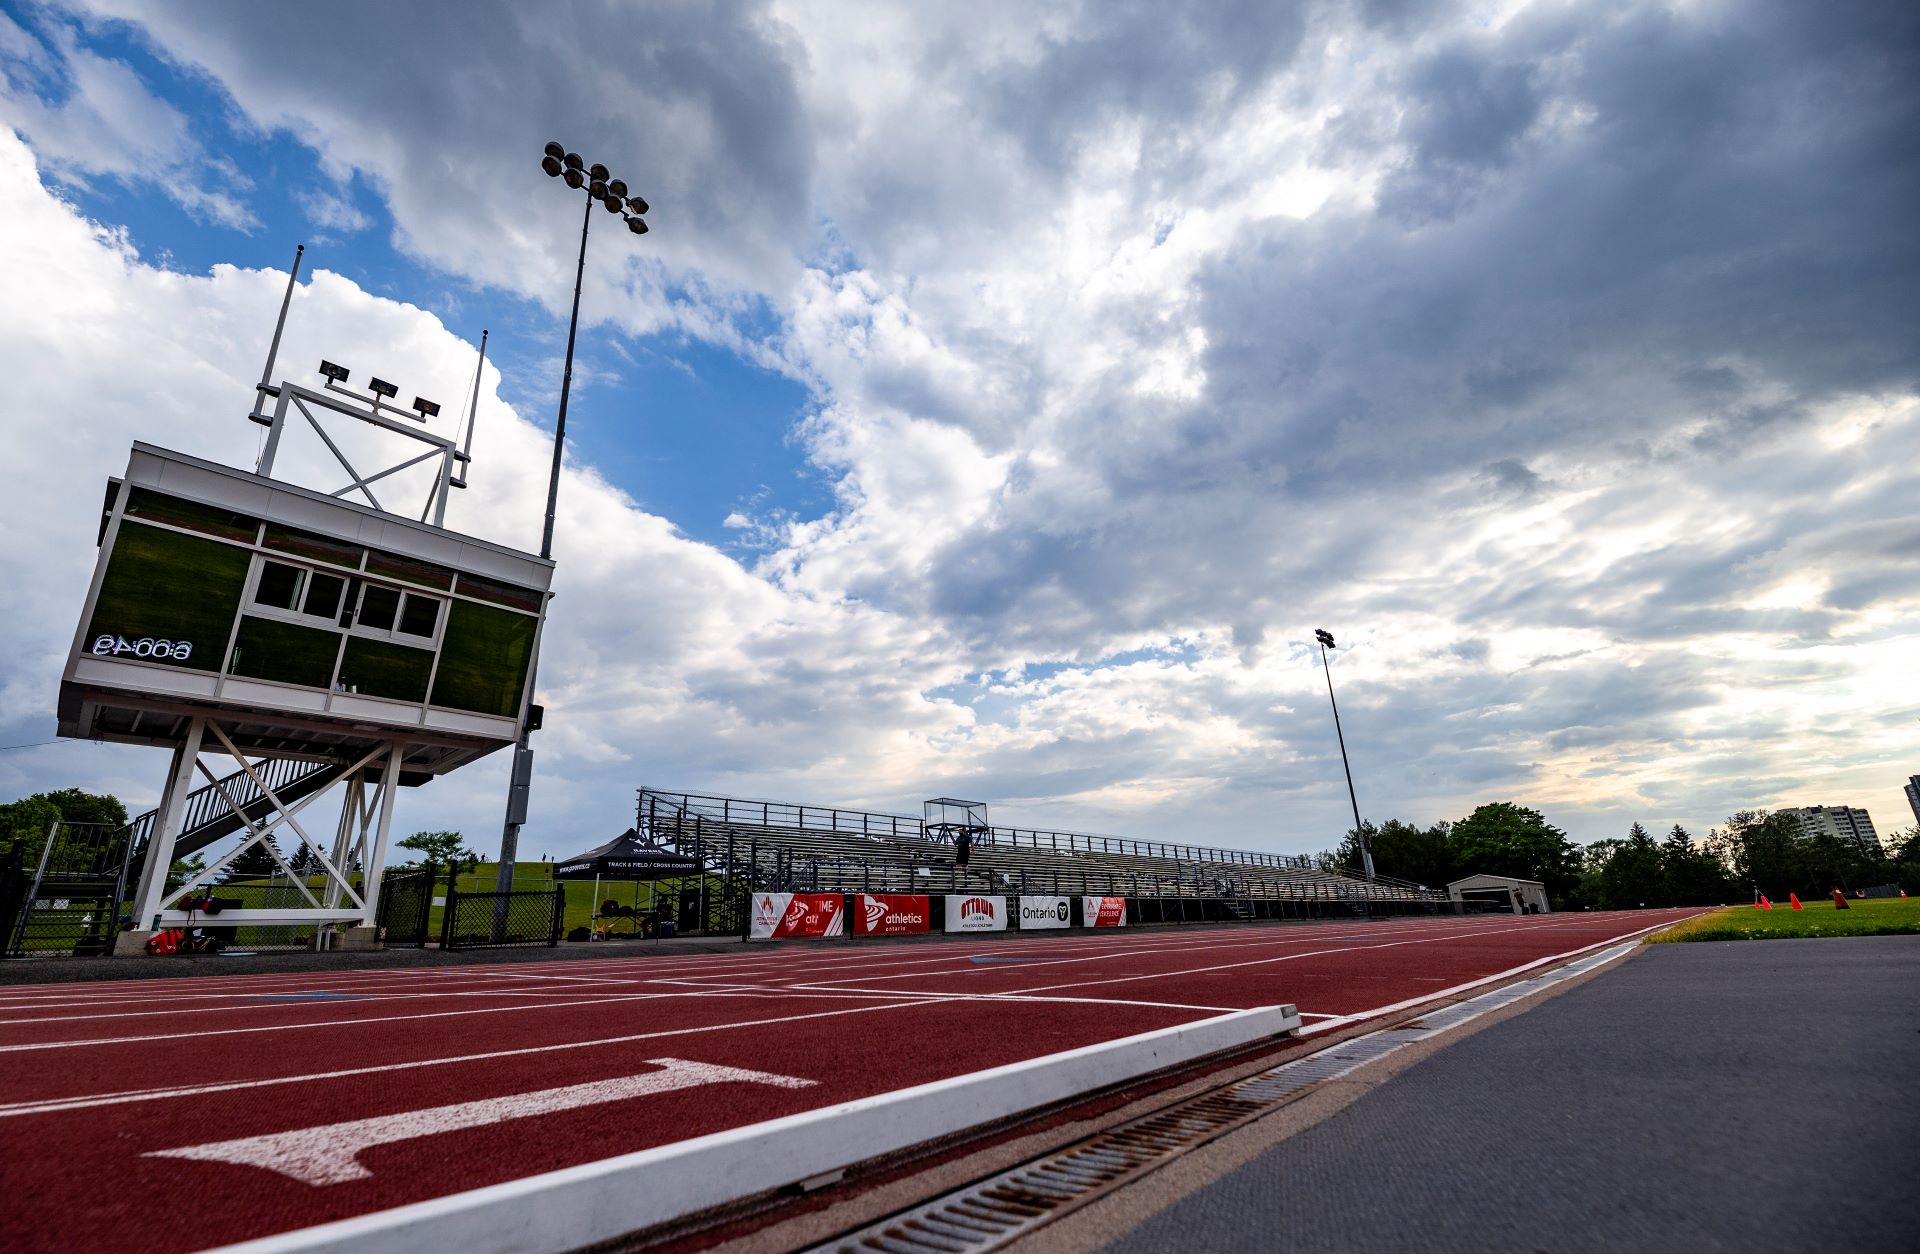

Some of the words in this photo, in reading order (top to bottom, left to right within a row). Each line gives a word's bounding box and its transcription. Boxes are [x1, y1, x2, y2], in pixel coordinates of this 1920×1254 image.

[961, 897, 994, 919] OTTAWA
[1022, 907, 1056, 919] Ontario
[885, 912, 922, 924] athletics
[142, 1057, 819, 1186] 1
